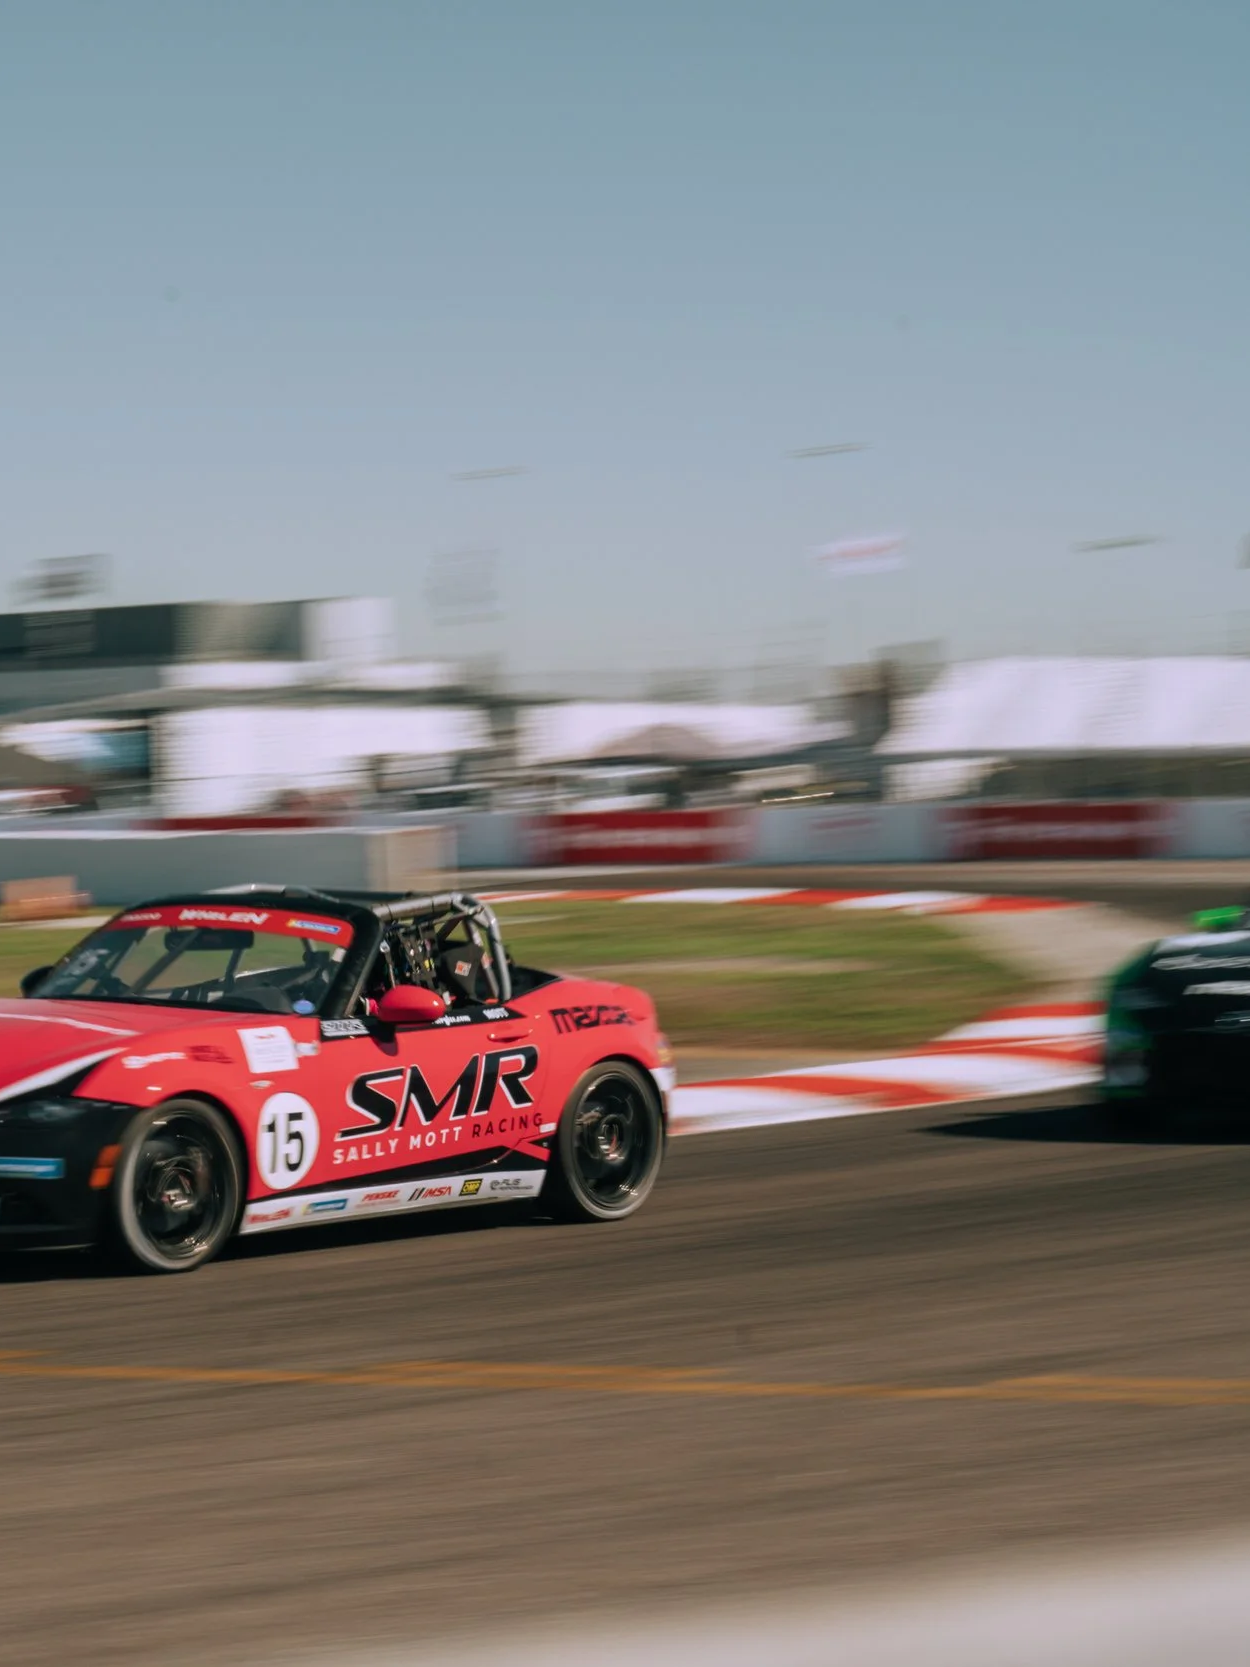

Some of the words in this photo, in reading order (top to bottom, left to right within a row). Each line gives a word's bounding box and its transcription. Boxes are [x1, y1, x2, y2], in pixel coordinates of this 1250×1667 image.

[333, 1045, 539, 1141] SMR
[261, 1112, 304, 1174] 15
[333, 1139, 399, 1165] SALLY
[409, 1126, 463, 1150] MOTT
[472, 1112, 543, 1138] RACING
[421, 1186, 453, 1199] IMSA
